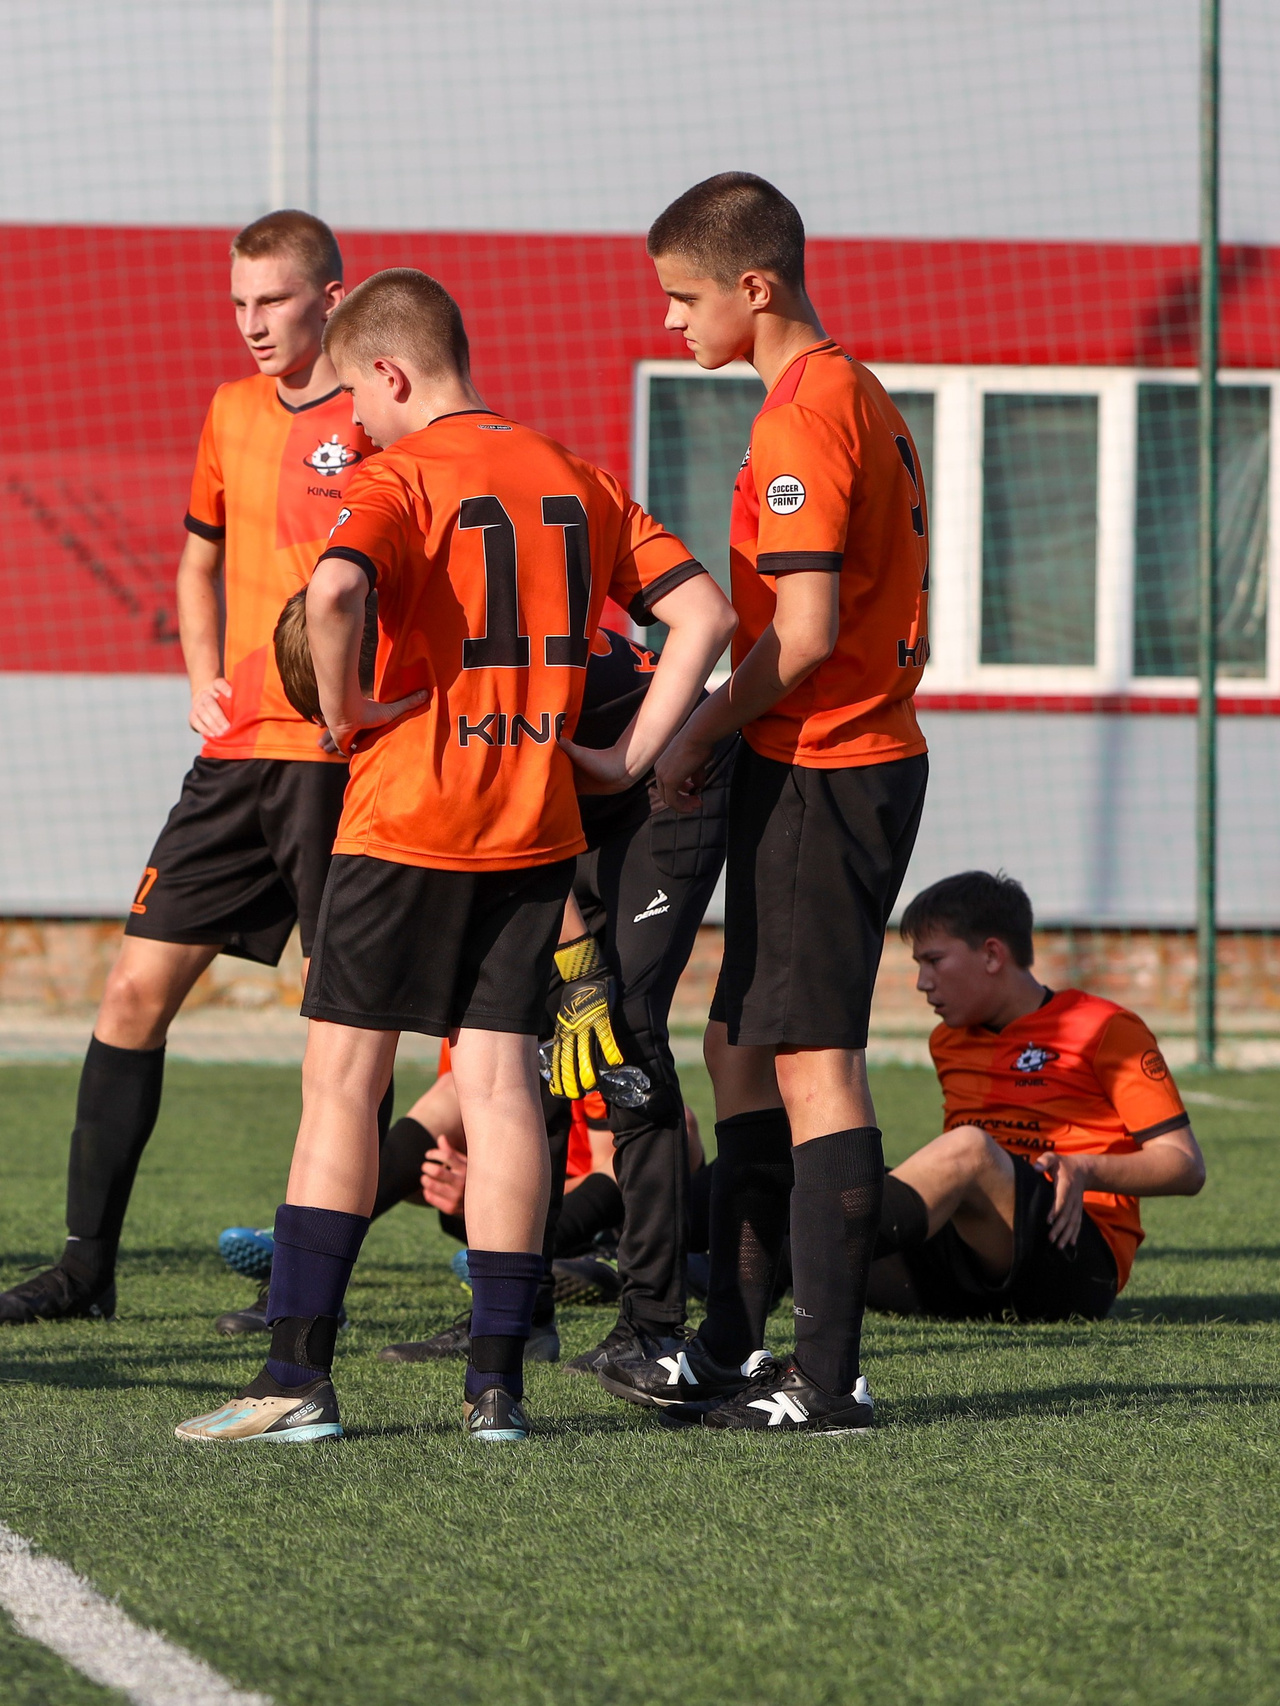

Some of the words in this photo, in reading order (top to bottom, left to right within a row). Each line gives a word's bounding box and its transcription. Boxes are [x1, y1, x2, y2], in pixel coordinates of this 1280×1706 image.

[772, 484, 799, 494] SOCCER
[772, 496, 798, 506] PRINT
[458, 495, 592, 669] 11
[285, 1401, 317, 1426] MESSI
